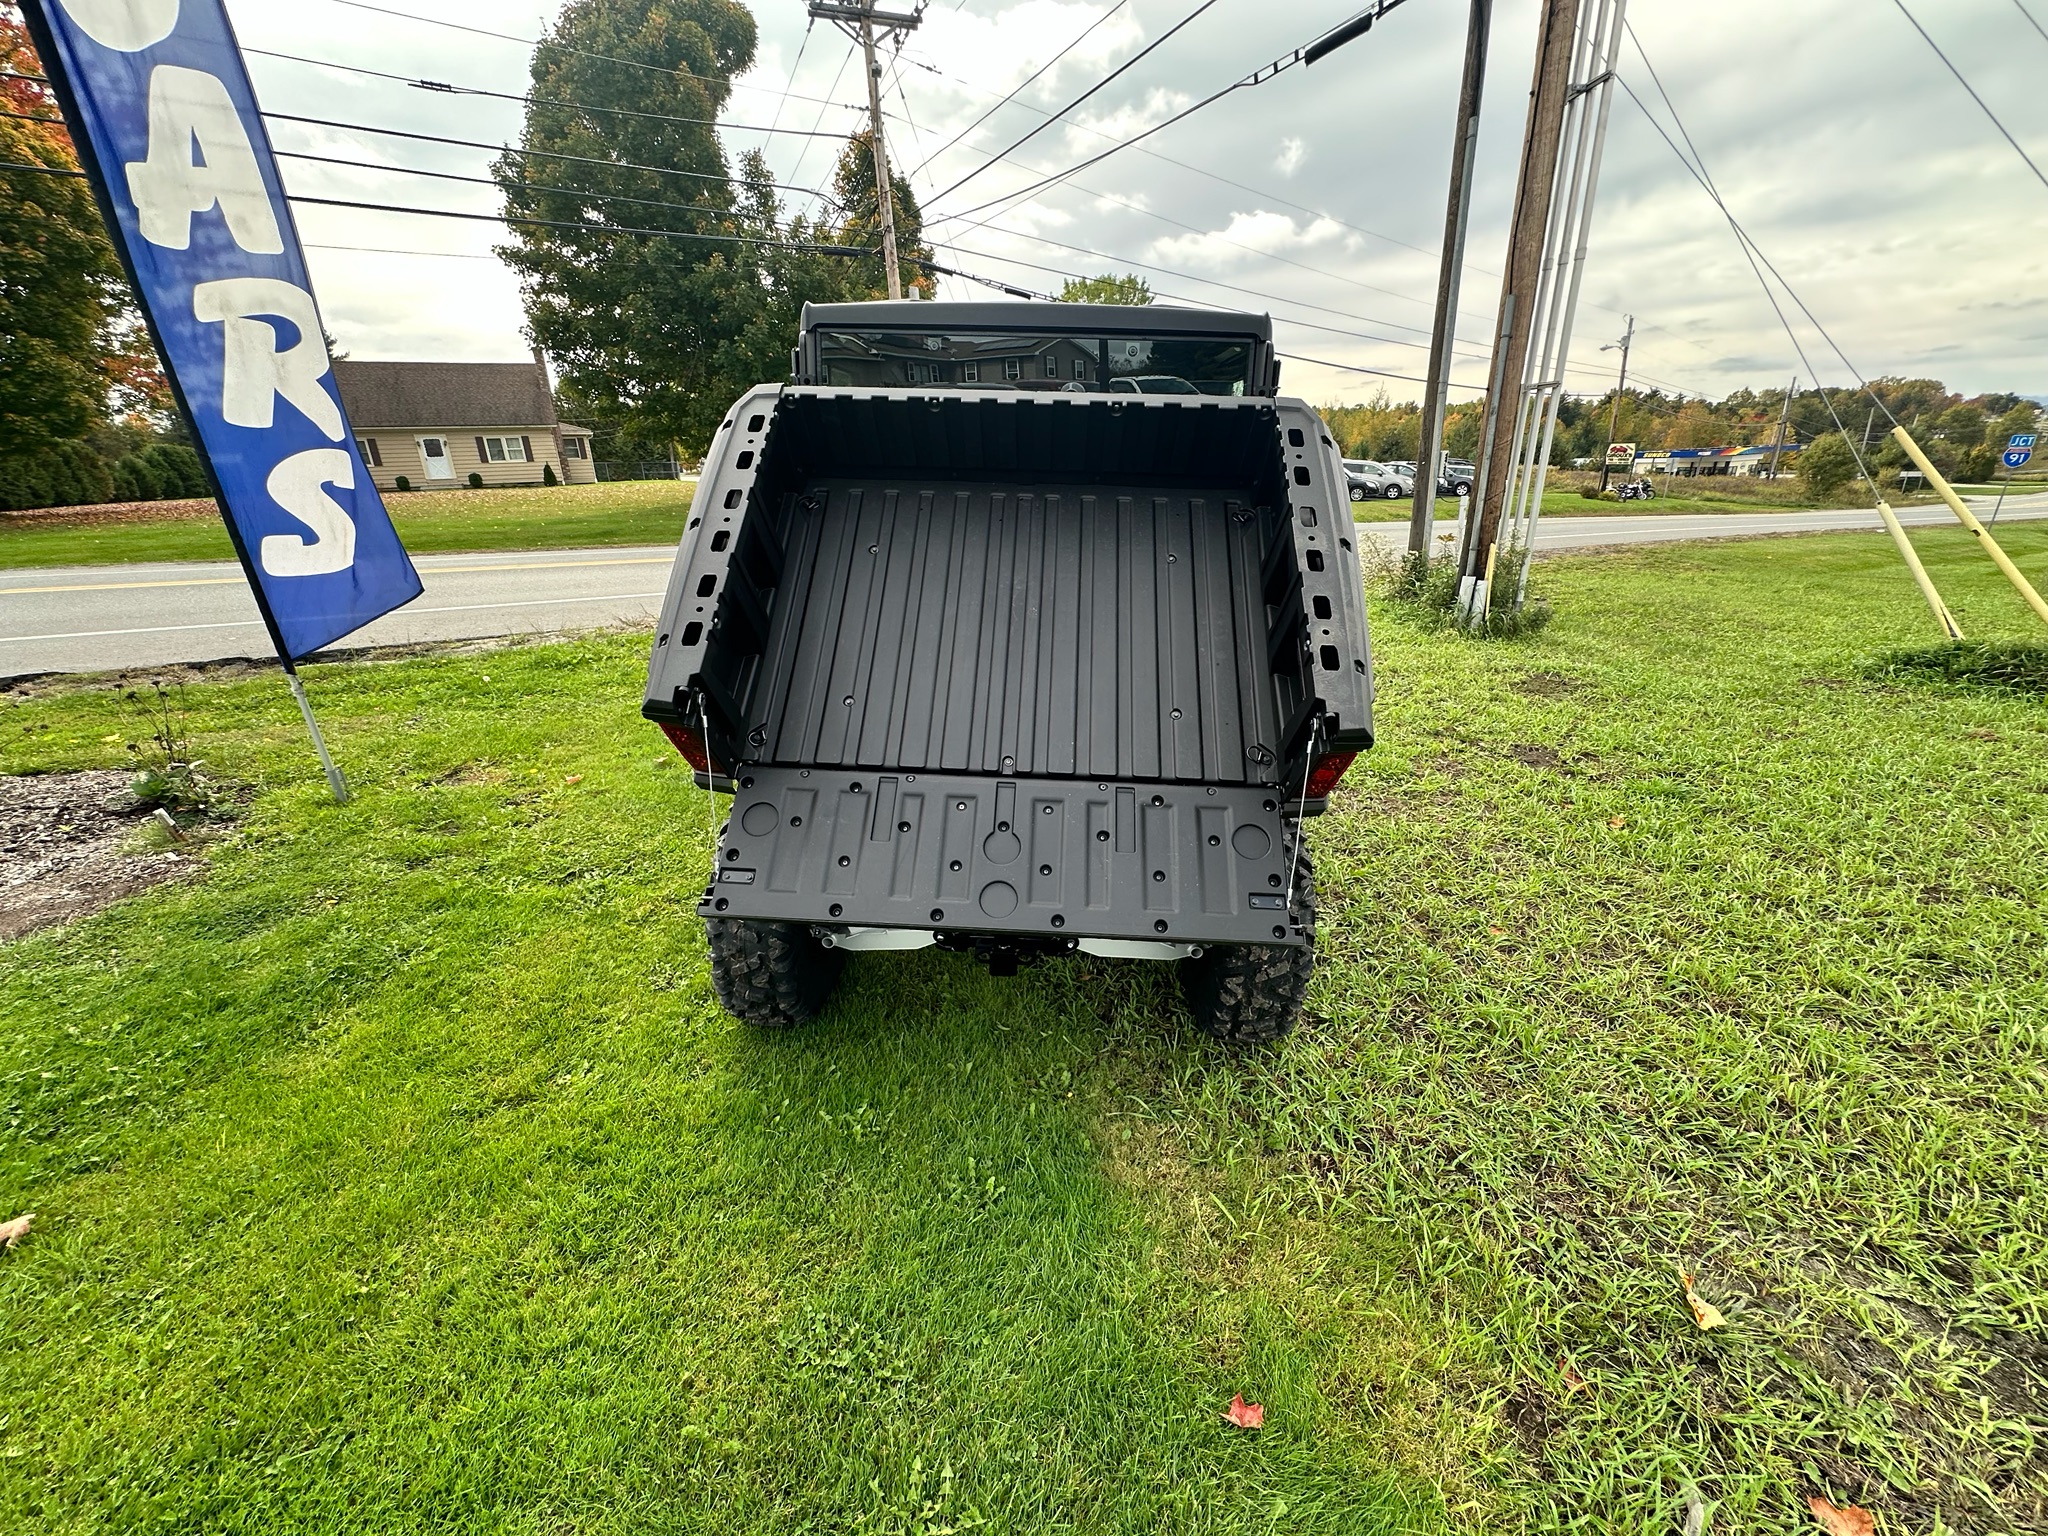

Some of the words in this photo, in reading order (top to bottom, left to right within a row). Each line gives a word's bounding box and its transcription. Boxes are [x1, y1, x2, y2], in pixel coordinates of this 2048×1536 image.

[60, 0, 356, 577] ARS
[2011, 436, 2035, 446] JCT
[2009, 453, 2025, 463] 91
